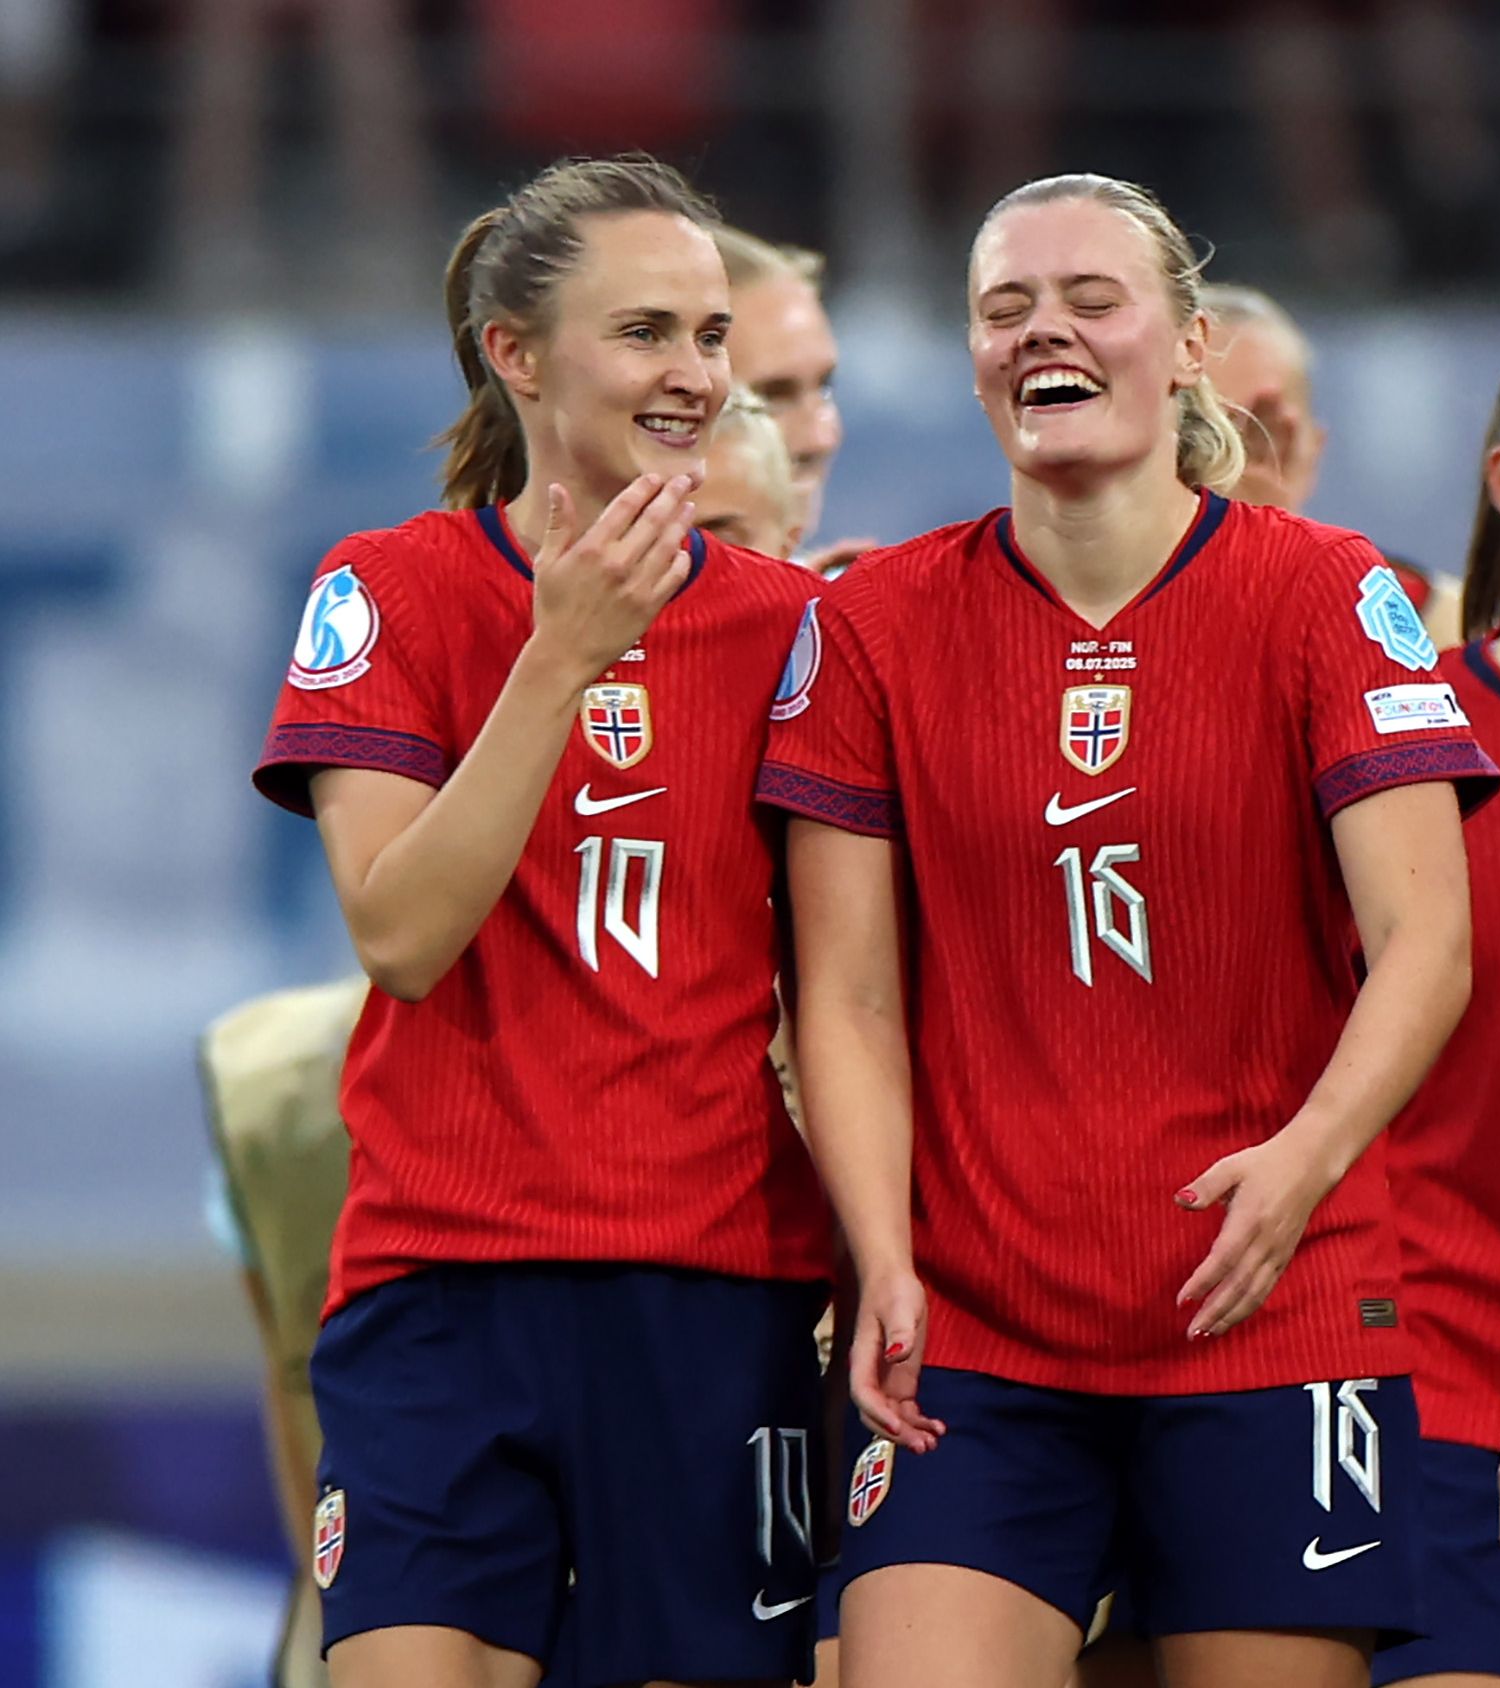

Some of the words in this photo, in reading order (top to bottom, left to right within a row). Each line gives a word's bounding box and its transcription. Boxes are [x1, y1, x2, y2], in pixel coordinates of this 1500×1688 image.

[1071, 640, 1099, 654] NOR
[1109, 640, 1133, 653] FIN
[573, 835, 665, 979] 10
[1054, 843, 1153, 988] 16
[746, 1426, 815, 1566] 10
[1303, 1378, 1381, 1514] 16
